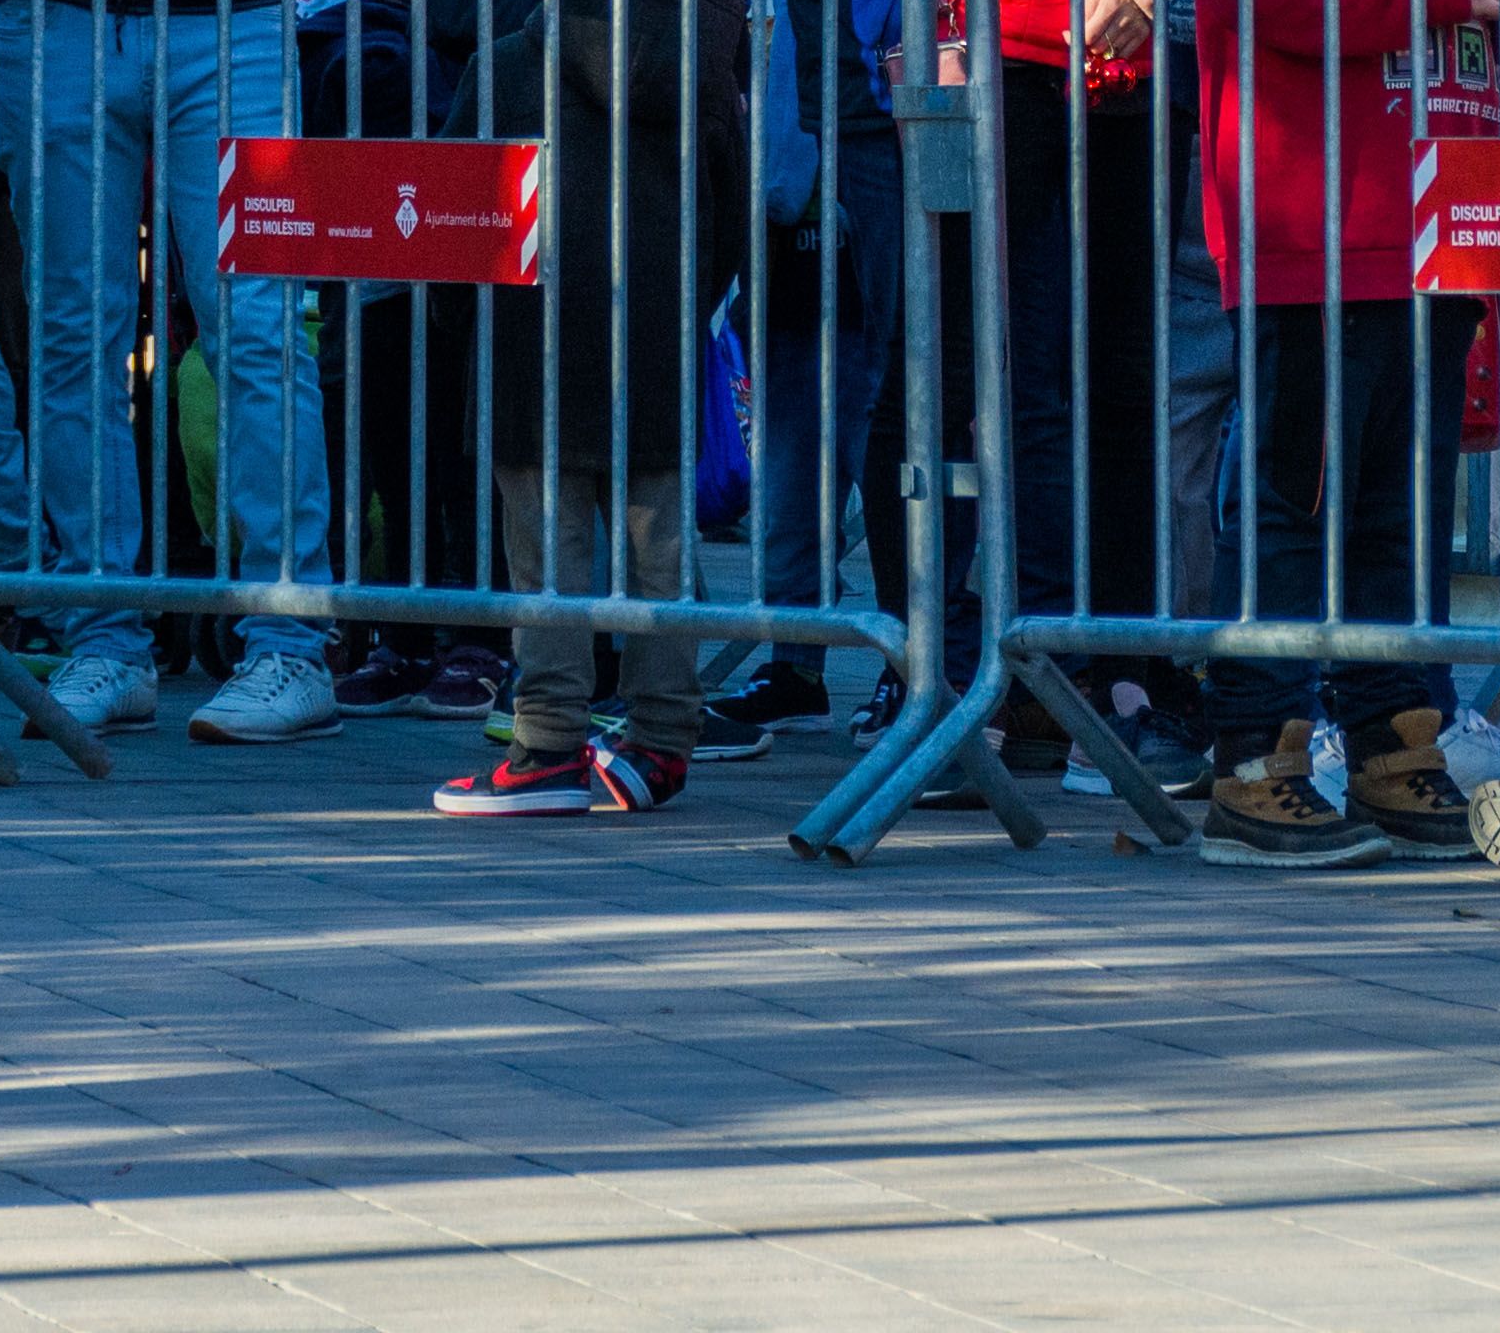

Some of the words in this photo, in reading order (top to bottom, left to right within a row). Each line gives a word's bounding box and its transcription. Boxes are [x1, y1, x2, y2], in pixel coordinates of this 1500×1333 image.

[244, 197, 295, 213] DISCULPEU
[244, 220, 261, 234] LES
[262, 218, 315, 236] MOLÈSTIES!
[425, 209, 477, 228] Ajuntament
[479, 211, 491, 227] de
[1451, 231, 1474, 246] LES
